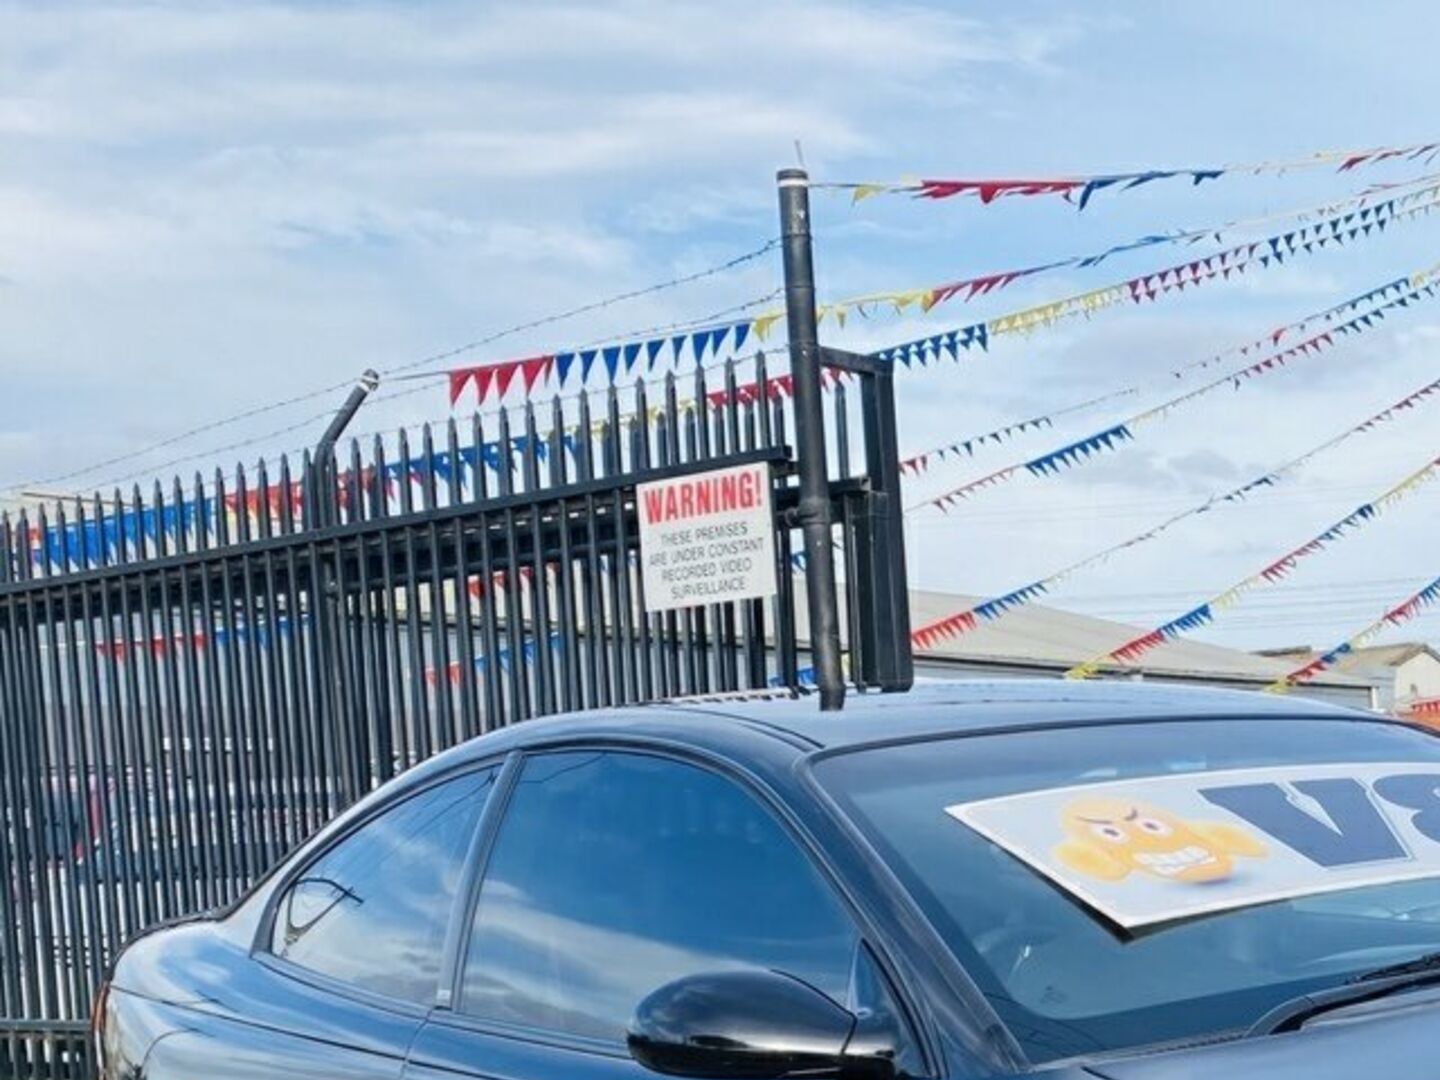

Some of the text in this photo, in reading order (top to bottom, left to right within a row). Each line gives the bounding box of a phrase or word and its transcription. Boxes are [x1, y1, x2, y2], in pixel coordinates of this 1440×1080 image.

[644, 470, 763, 525] WARNING!
[661, 521, 748, 546] THESE PREMISES
[649, 537, 764, 566] ARE UNDER CONSTANT
[662, 557, 752, 581] RECORDED VIDEO
[671, 577, 746, 600] SURVEILLANCE
